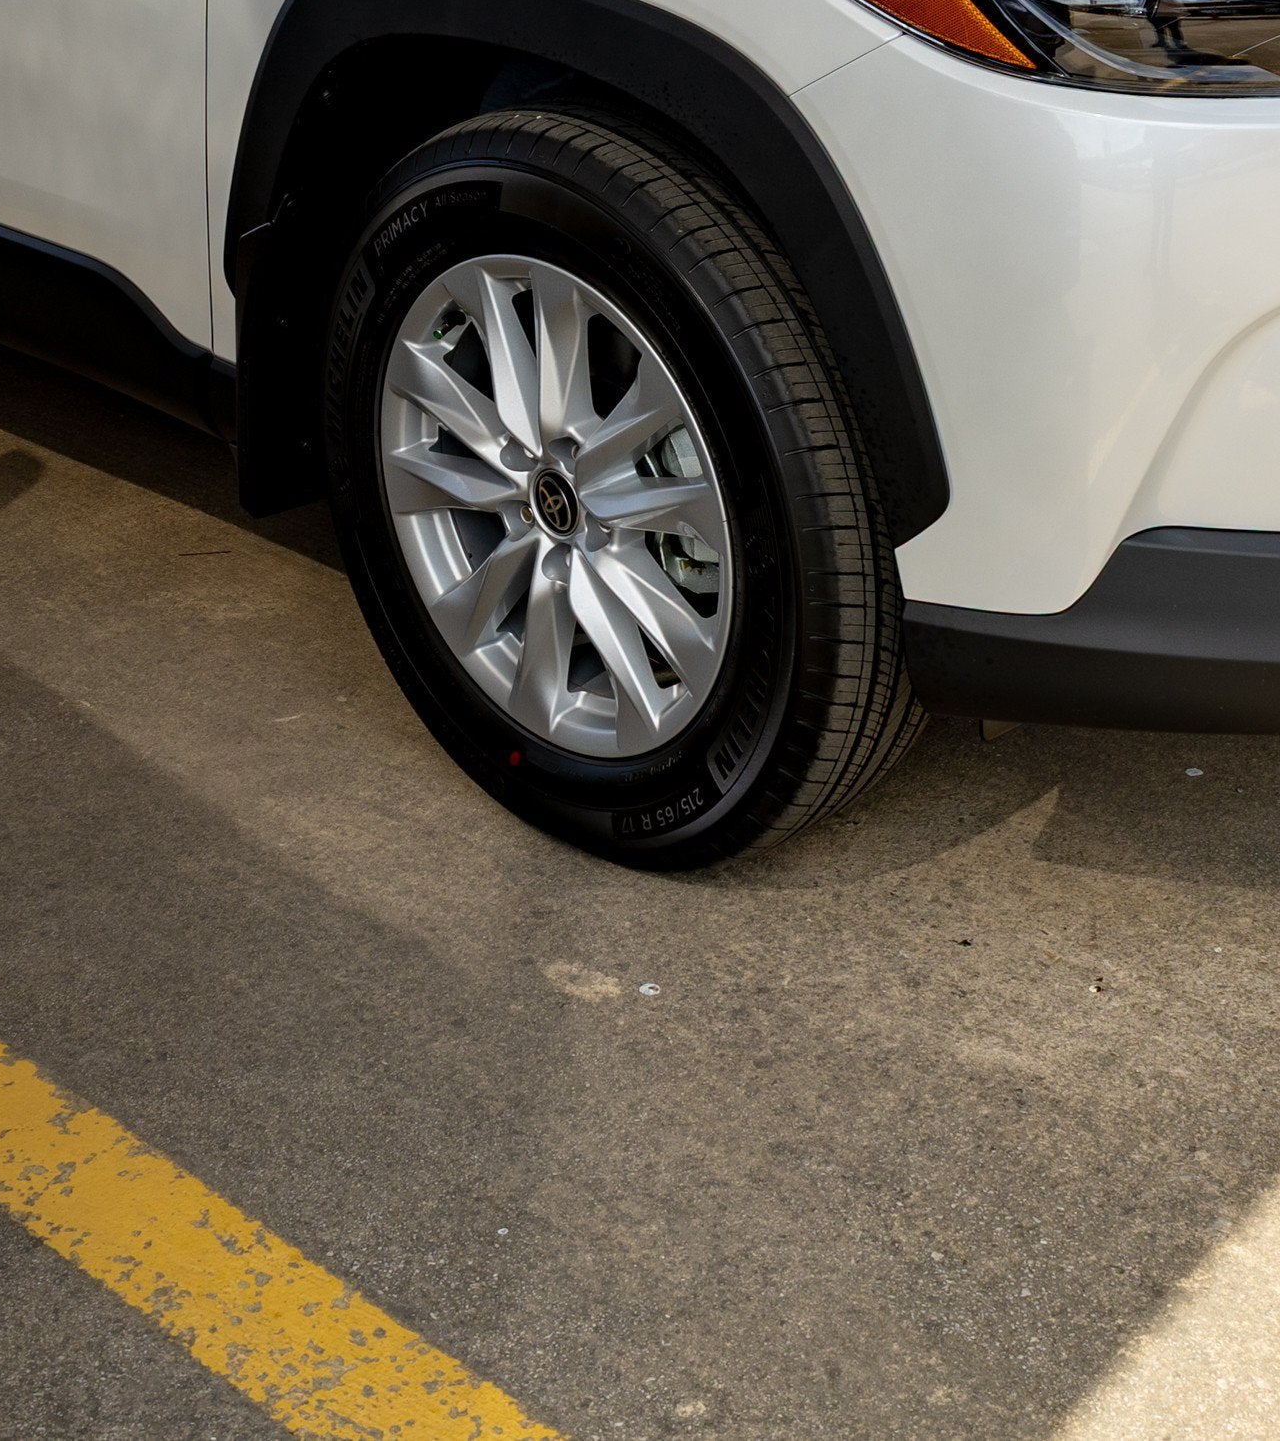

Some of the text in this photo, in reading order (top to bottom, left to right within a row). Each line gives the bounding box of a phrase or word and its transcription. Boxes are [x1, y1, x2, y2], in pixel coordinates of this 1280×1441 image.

[373, 199, 430, 257] PRIMACY
[434, 195, 447, 208] All
[622, 788, 705, 835] 215/65 R 17
